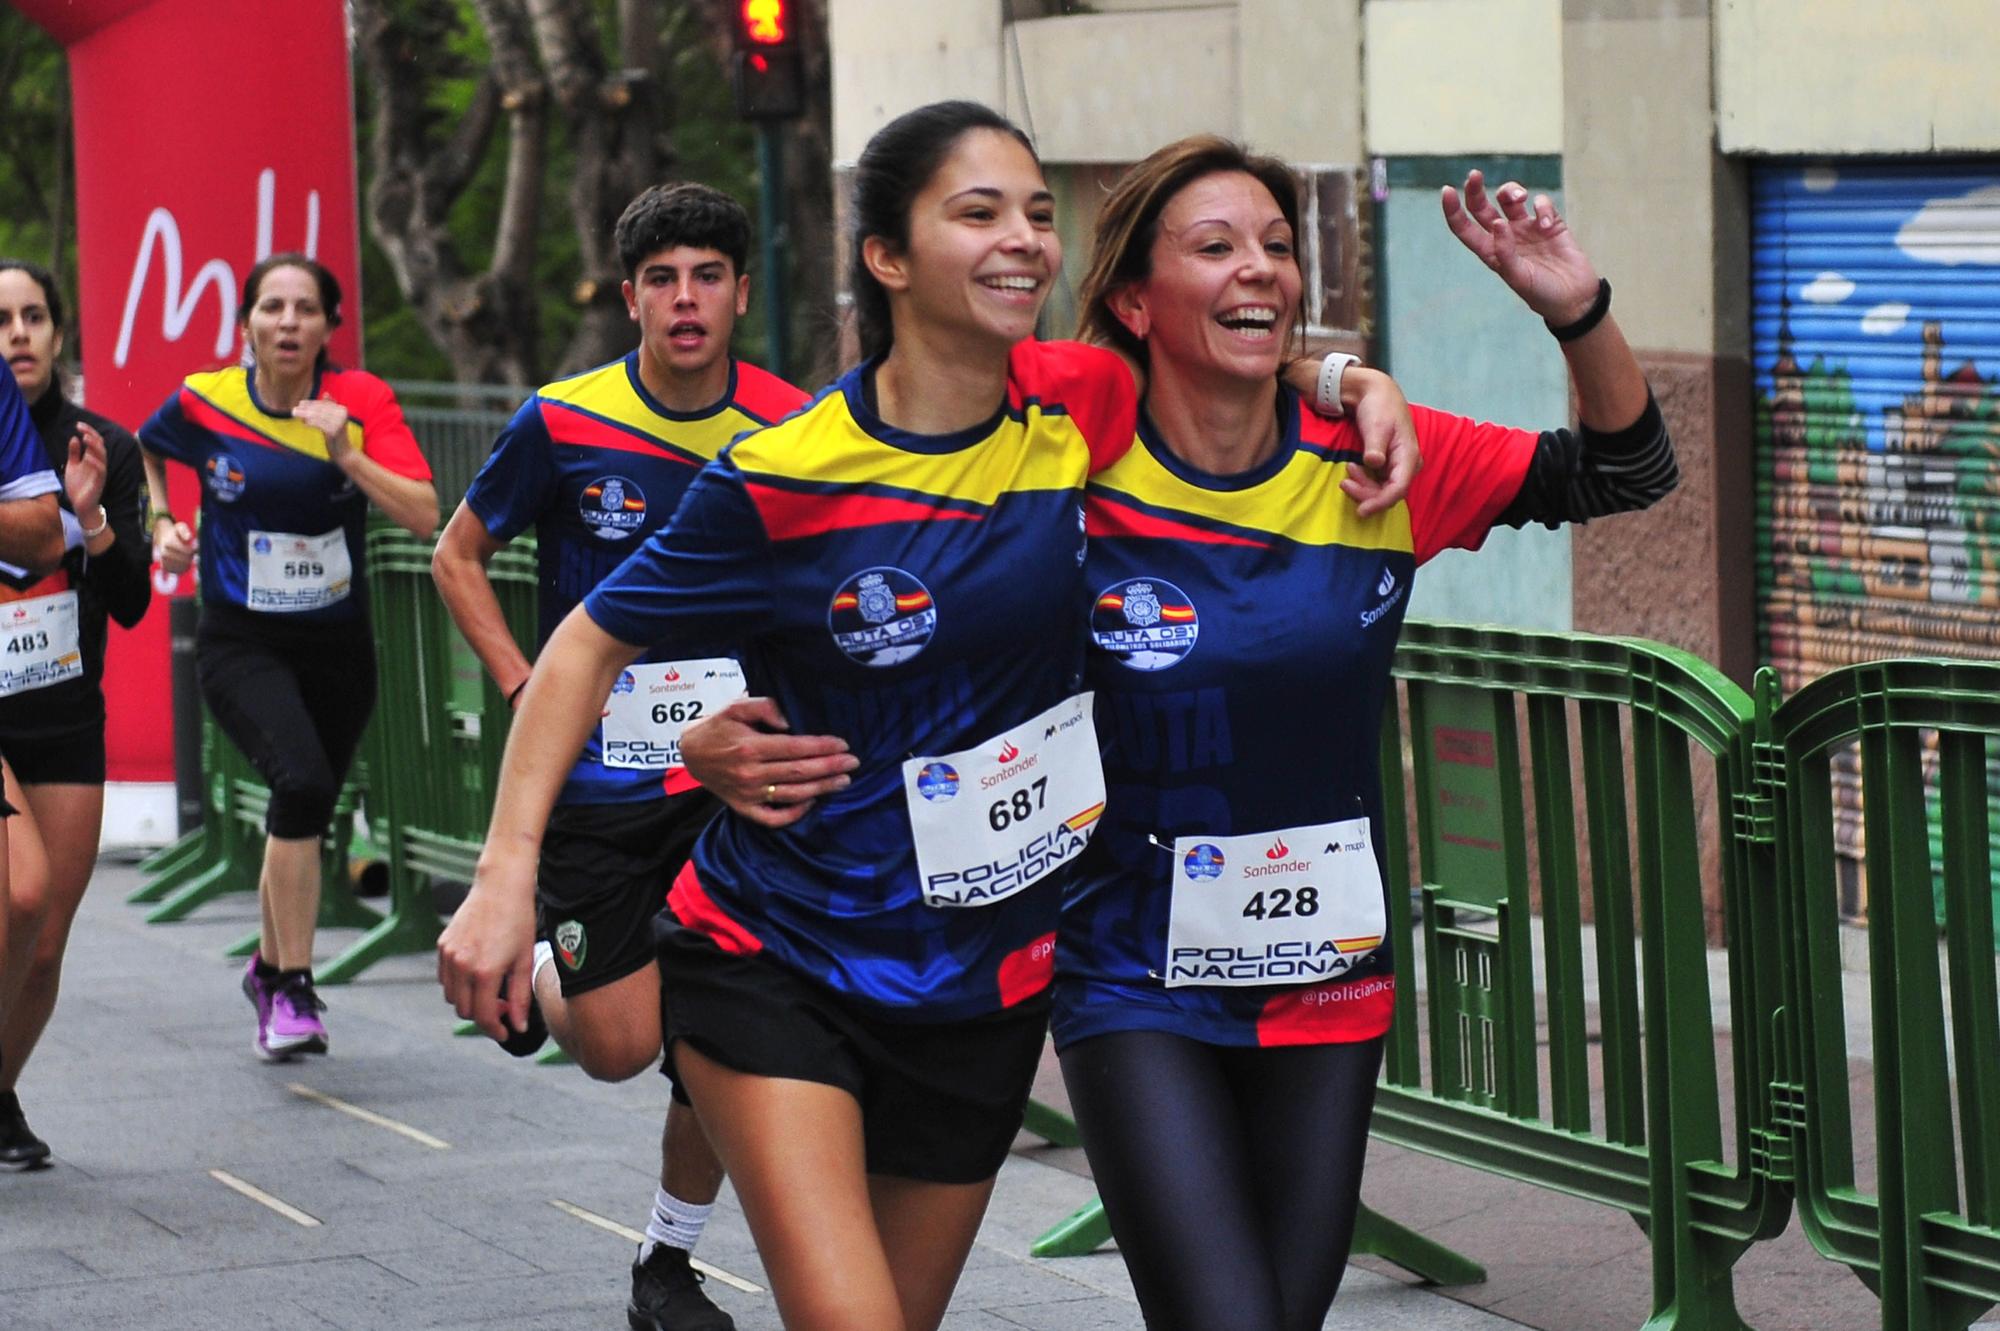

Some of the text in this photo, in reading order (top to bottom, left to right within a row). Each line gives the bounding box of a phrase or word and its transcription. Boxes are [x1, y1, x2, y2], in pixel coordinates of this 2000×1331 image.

[7, 630, 49, 654] 483
[1098, 625, 1195, 644] RUTA 091
[649, 683, 695, 694] Santander
[652, 701, 703, 723] 662
[981, 753, 1039, 790] Santander
[989, 775, 1048, 832] 687
[928, 822, 1072, 891] POLICIA
[1243, 860, 1311, 878] Santander
[1243, 887, 1319, 921] 428
[1172, 940, 1340, 962] POLICIA
